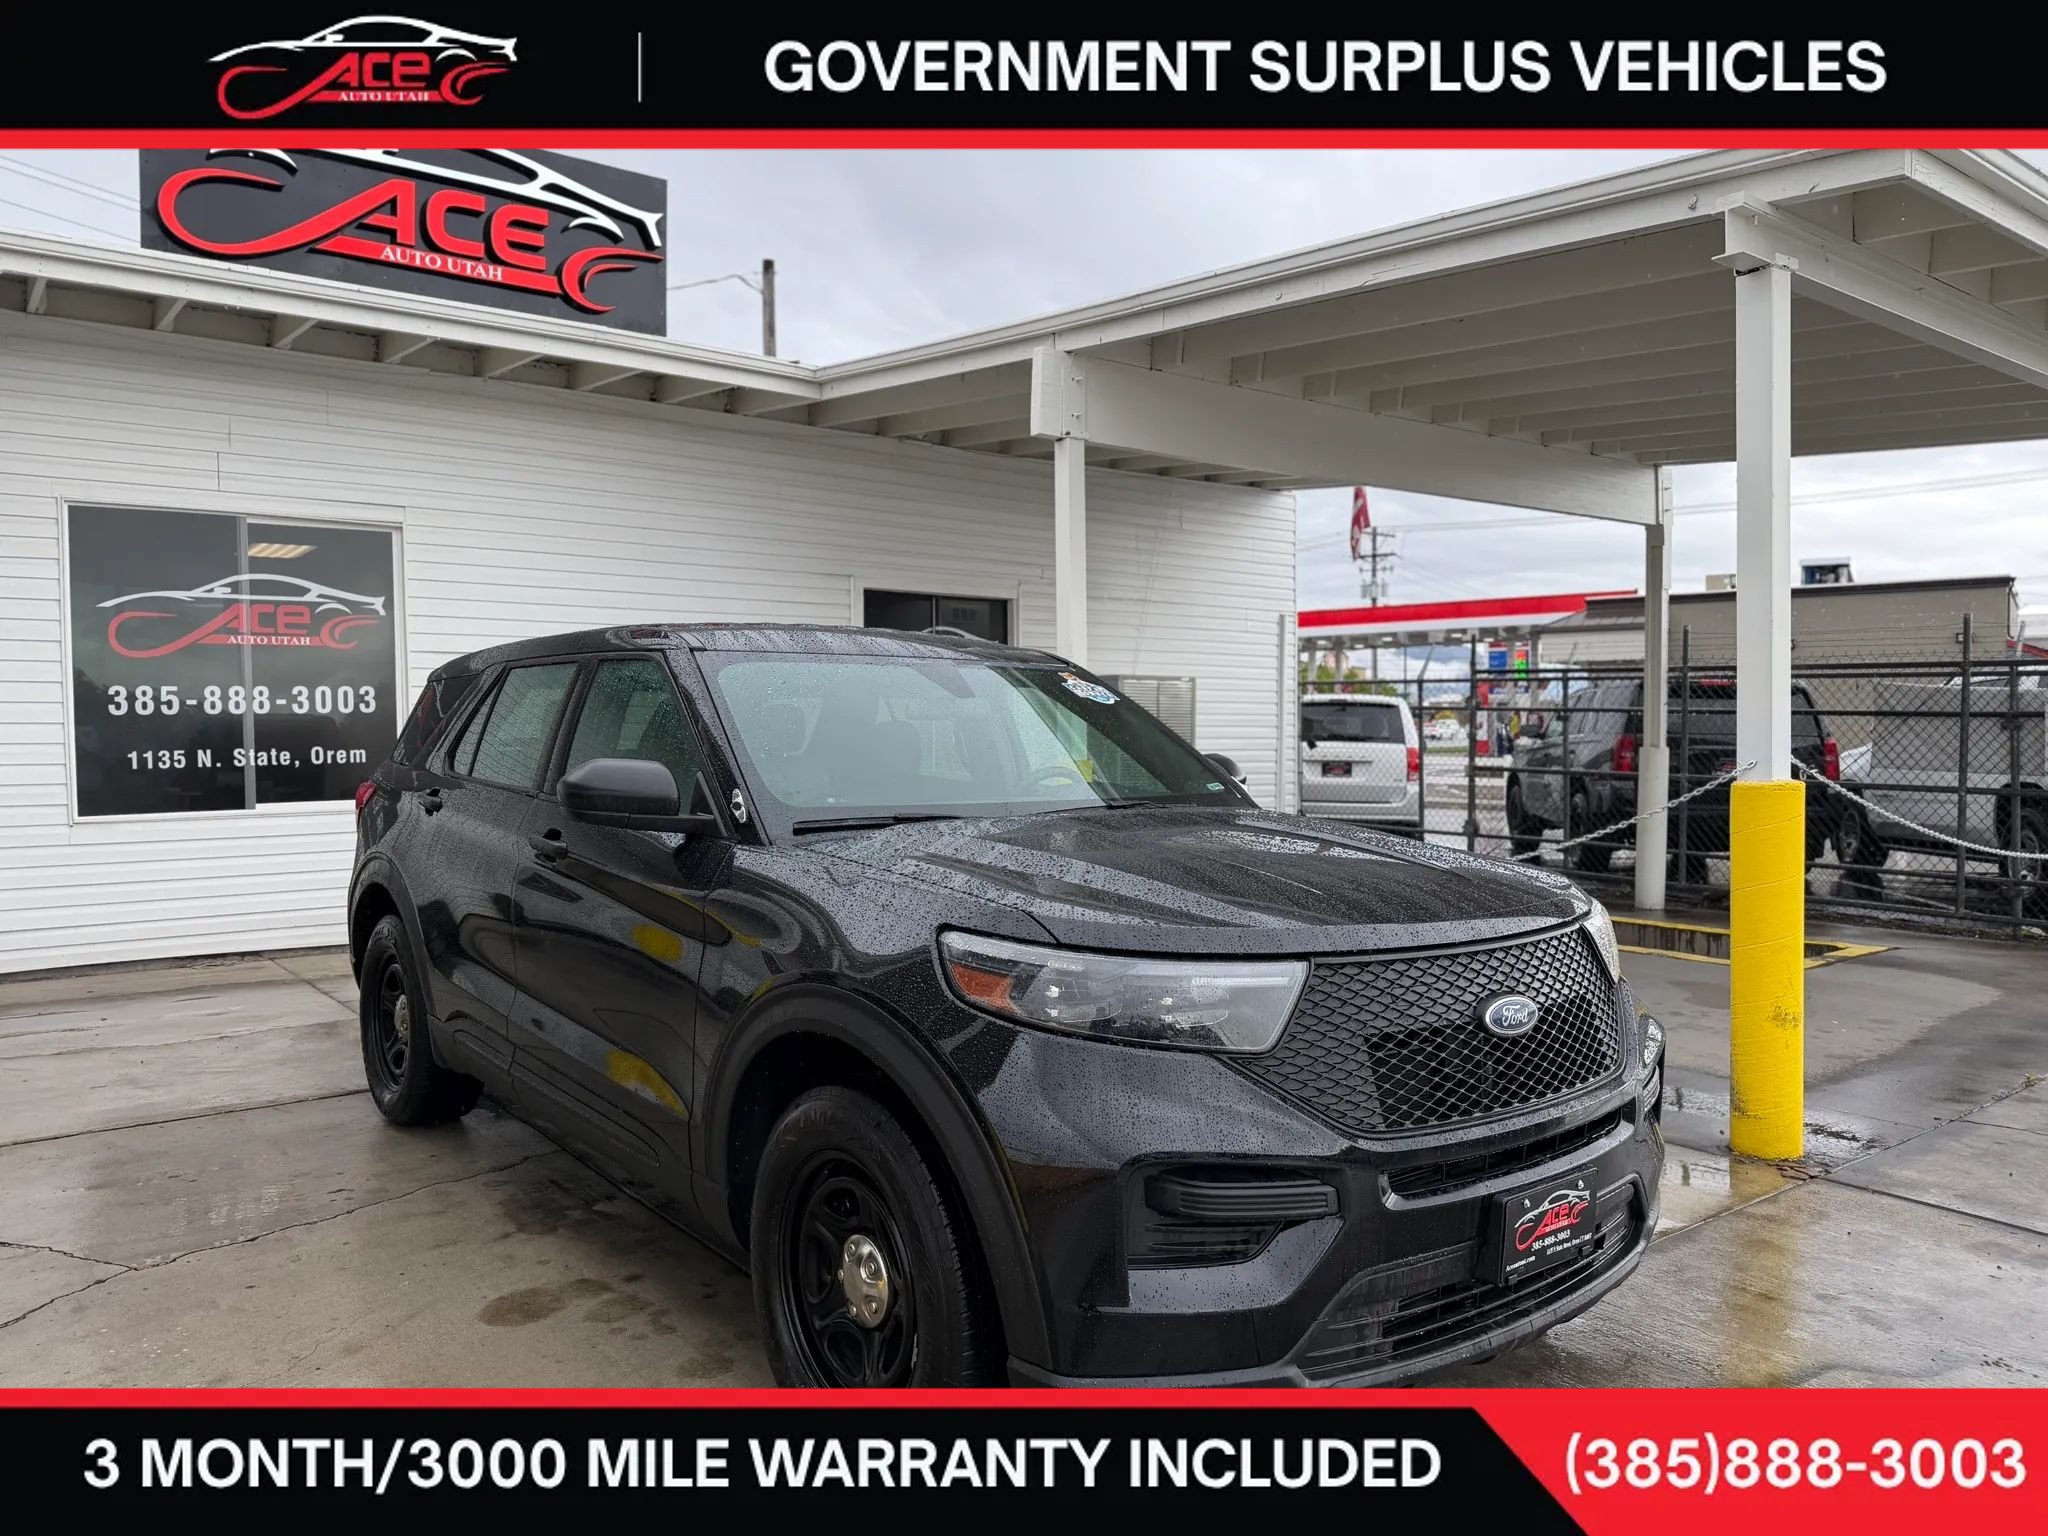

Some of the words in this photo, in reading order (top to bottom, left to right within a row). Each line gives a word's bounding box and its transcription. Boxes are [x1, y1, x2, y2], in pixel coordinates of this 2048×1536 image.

[380, 246, 442, 269] AUTO
[447, 256, 503, 281] UTAH
[227, 635, 268, 645] AUTO
[271, 636, 310, 646] UTAH
[108, 685, 376, 716] 385-888-3003
[127, 750, 186, 769] 1135
[197, 749, 222, 768] N.
[233, 747, 300, 768] State,
[311, 746, 367, 764] Orem
[1502, 1004, 1529, 1027] Ford
